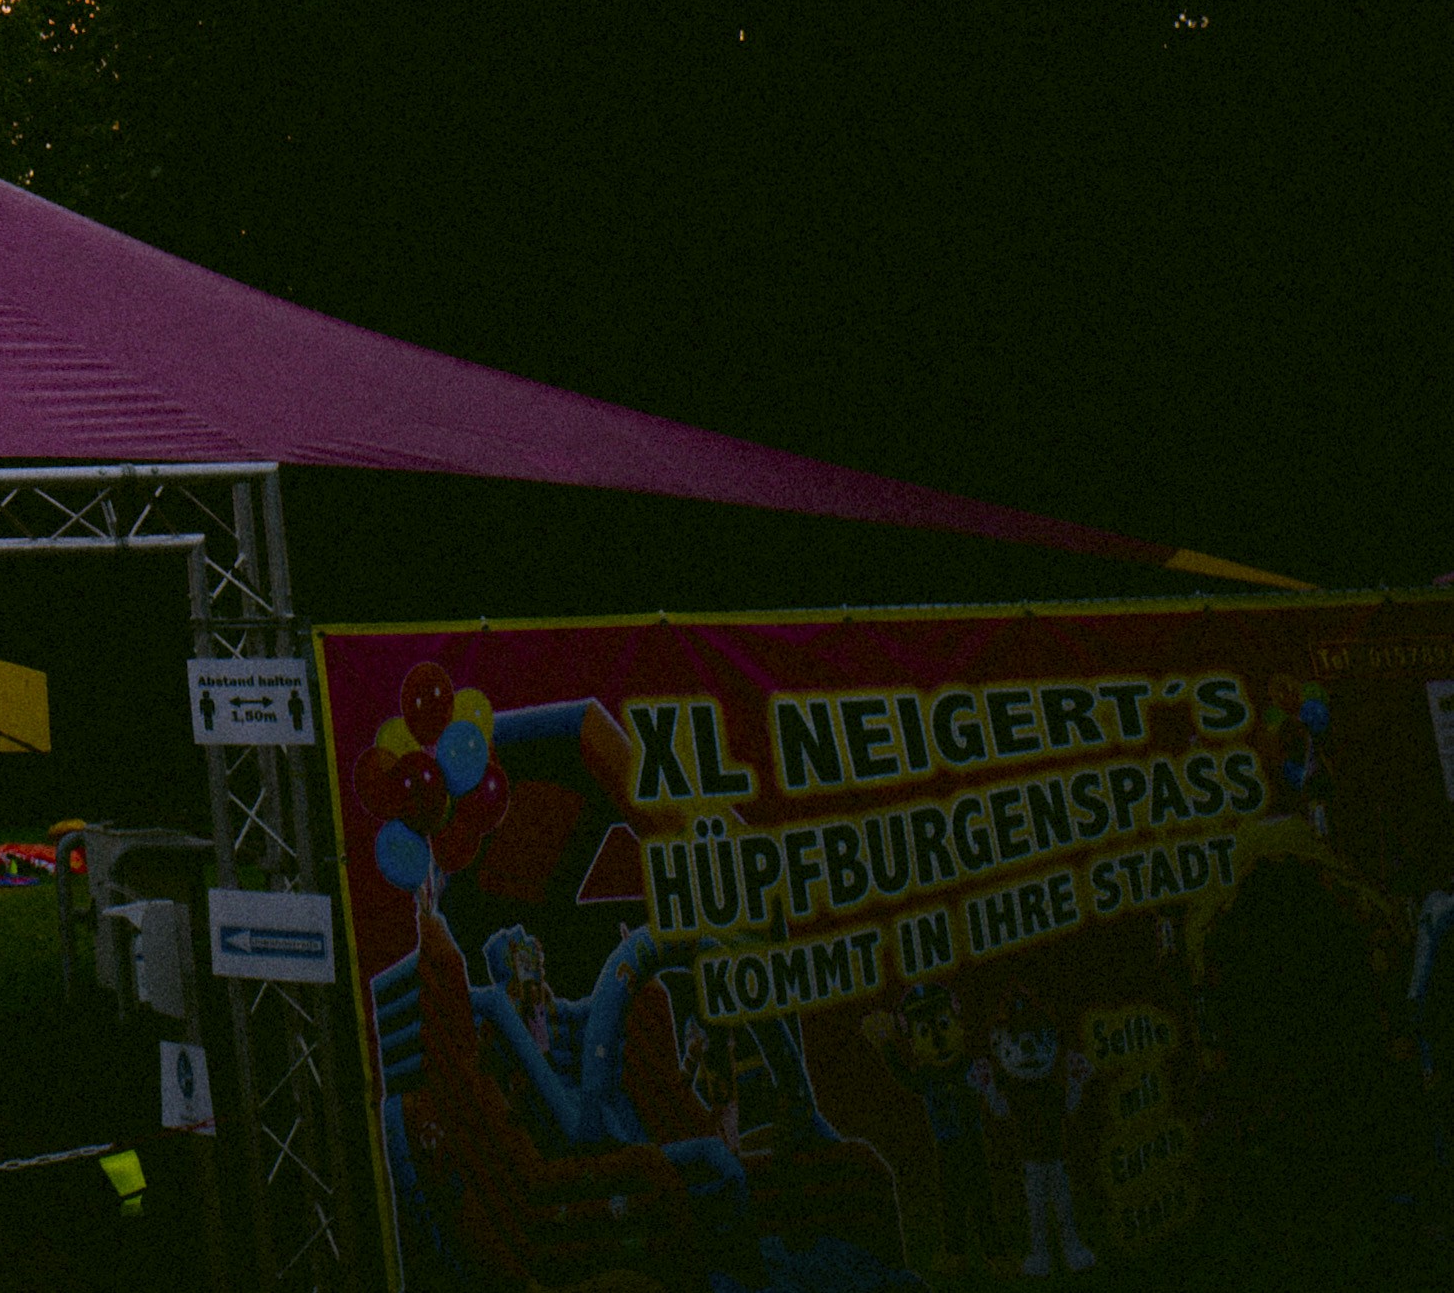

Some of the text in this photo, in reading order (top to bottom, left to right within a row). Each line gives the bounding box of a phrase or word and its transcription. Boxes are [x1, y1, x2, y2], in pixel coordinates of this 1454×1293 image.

[198, 675, 302, 687] Abstand halten
[231, 710, 278, 725] 1,50m
[628, 702, 751, 800] XL
[646, 752, 1267, 931] HÜPFBURGENSPASS
[701, 835, 1239, 1018] KOMMT IN IHRE STADT
